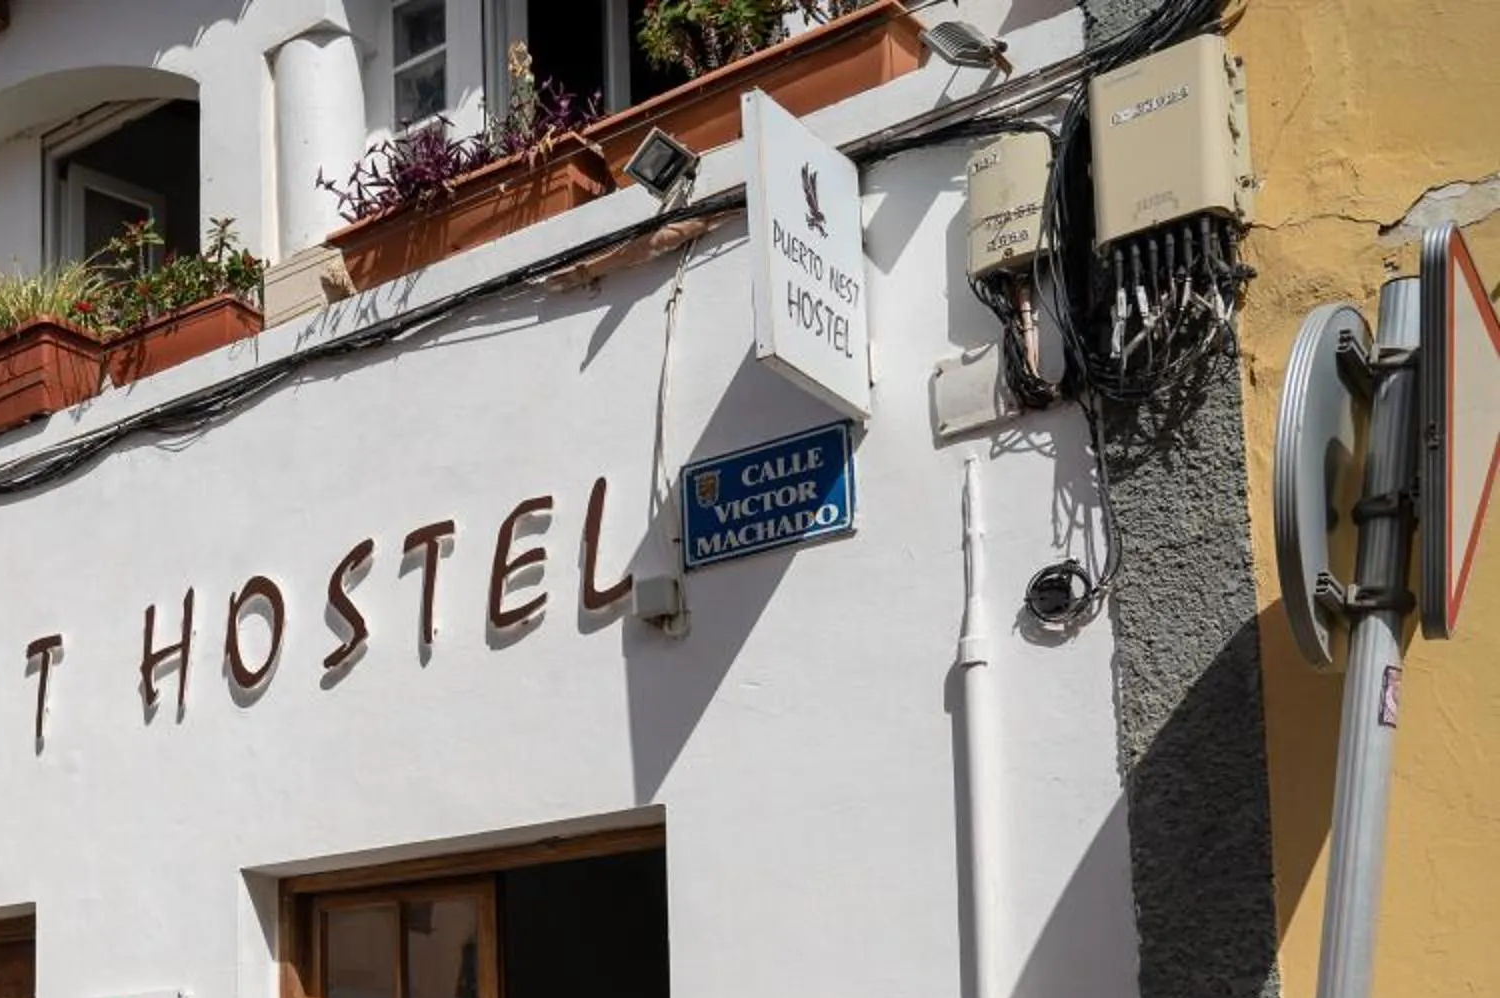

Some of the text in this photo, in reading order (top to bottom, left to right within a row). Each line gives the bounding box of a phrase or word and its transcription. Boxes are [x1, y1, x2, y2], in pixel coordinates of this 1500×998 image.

[773, 218, 859, 308] PUERTO NEST
[787, 280, 853, 359] HOSTEL
[741, 447, 825, 486] CALLE
[696, 503, 839, 557] MACHADO
[714, 481, 819, 524] VICTOR
[140, 477, 634, 707] HOSTEL
